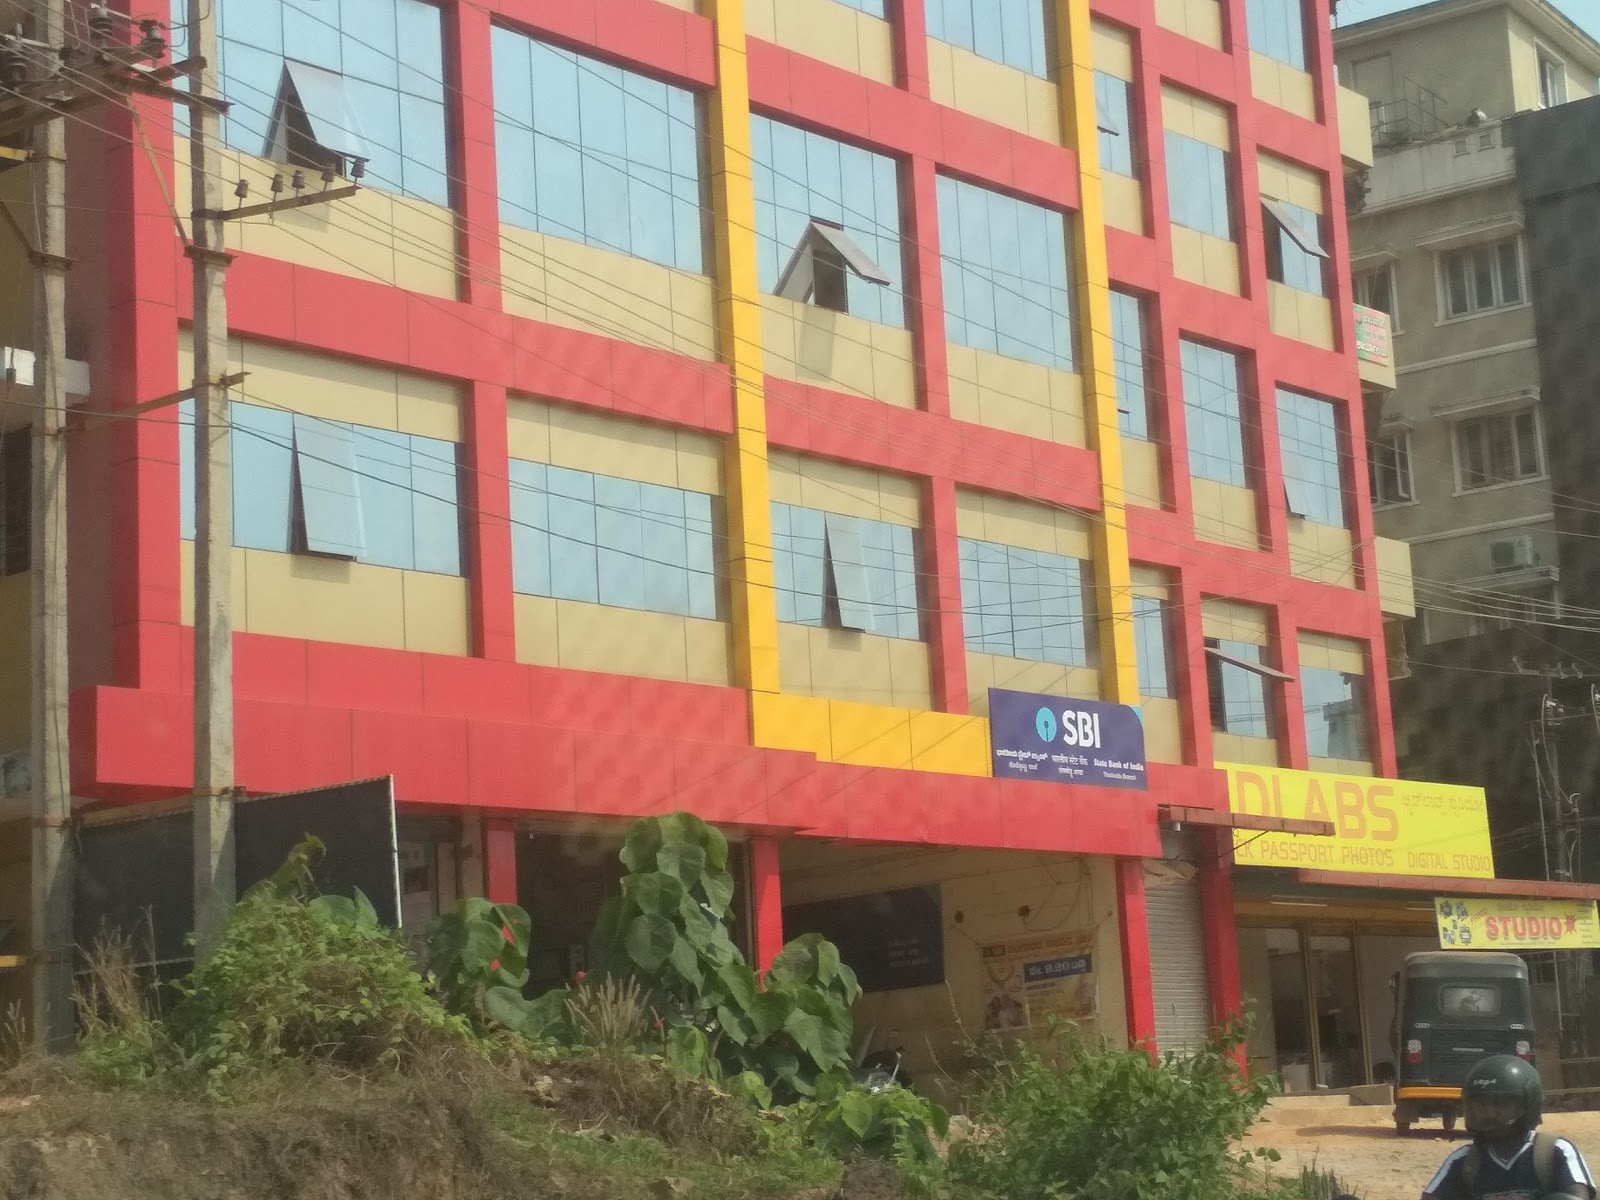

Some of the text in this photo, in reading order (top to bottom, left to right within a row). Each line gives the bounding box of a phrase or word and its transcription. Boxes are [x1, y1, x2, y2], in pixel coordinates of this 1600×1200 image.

[1062, 709, 1101, 748] SBI
[1093, 758, 1108, 768] State
[1108, 760, 1122, 769] Bank
[1130, 762, 1144, 771] India
[1260, 839, 1335, 865] PASSPORT
[1341, 845, 1394, 867] PHOTOS
[1408, 851, 1448, 871] DIGITAL
[1453, 853, 1491, 872] STUDIO
[1485, 915, 1563, 940] STUDIO
